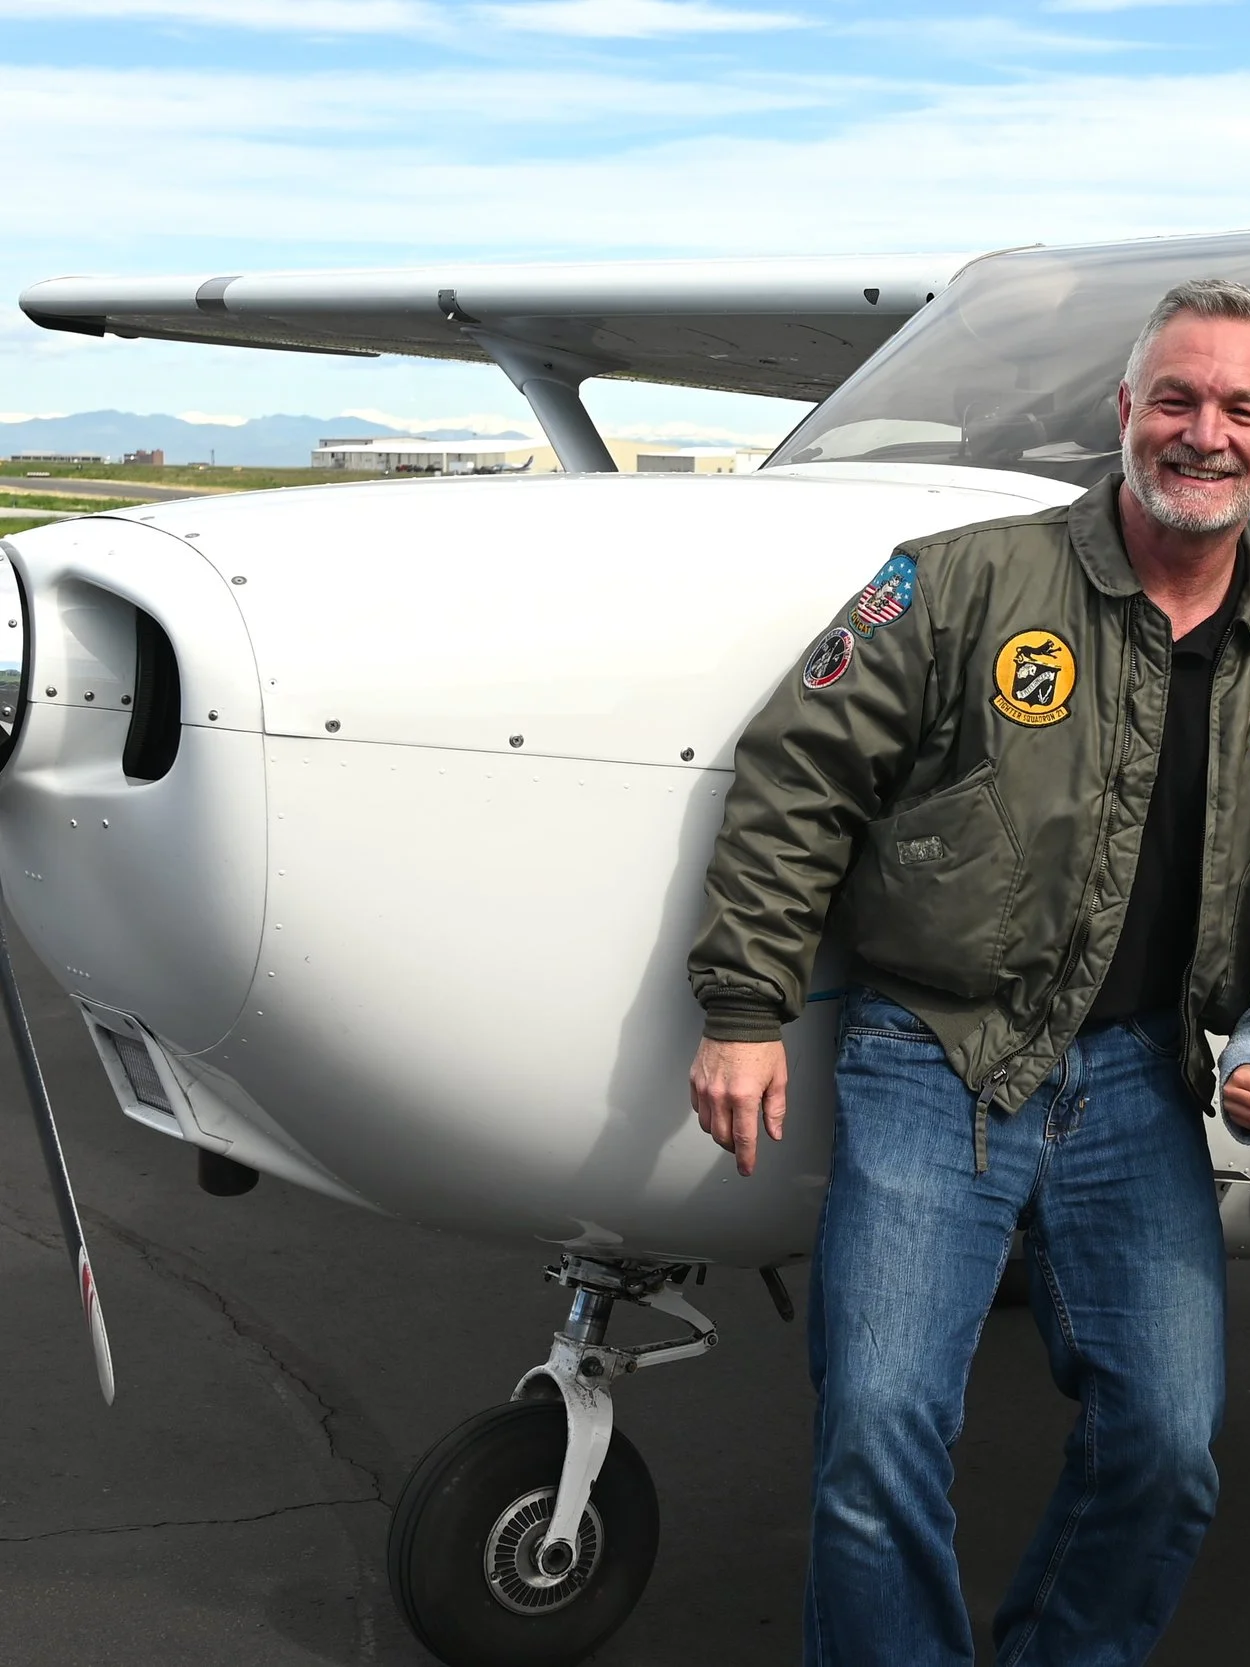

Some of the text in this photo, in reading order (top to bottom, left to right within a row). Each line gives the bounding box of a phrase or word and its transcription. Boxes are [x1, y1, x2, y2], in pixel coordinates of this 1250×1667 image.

[996, 697, 1065, 723] FIGHTER SQUADRON 21
